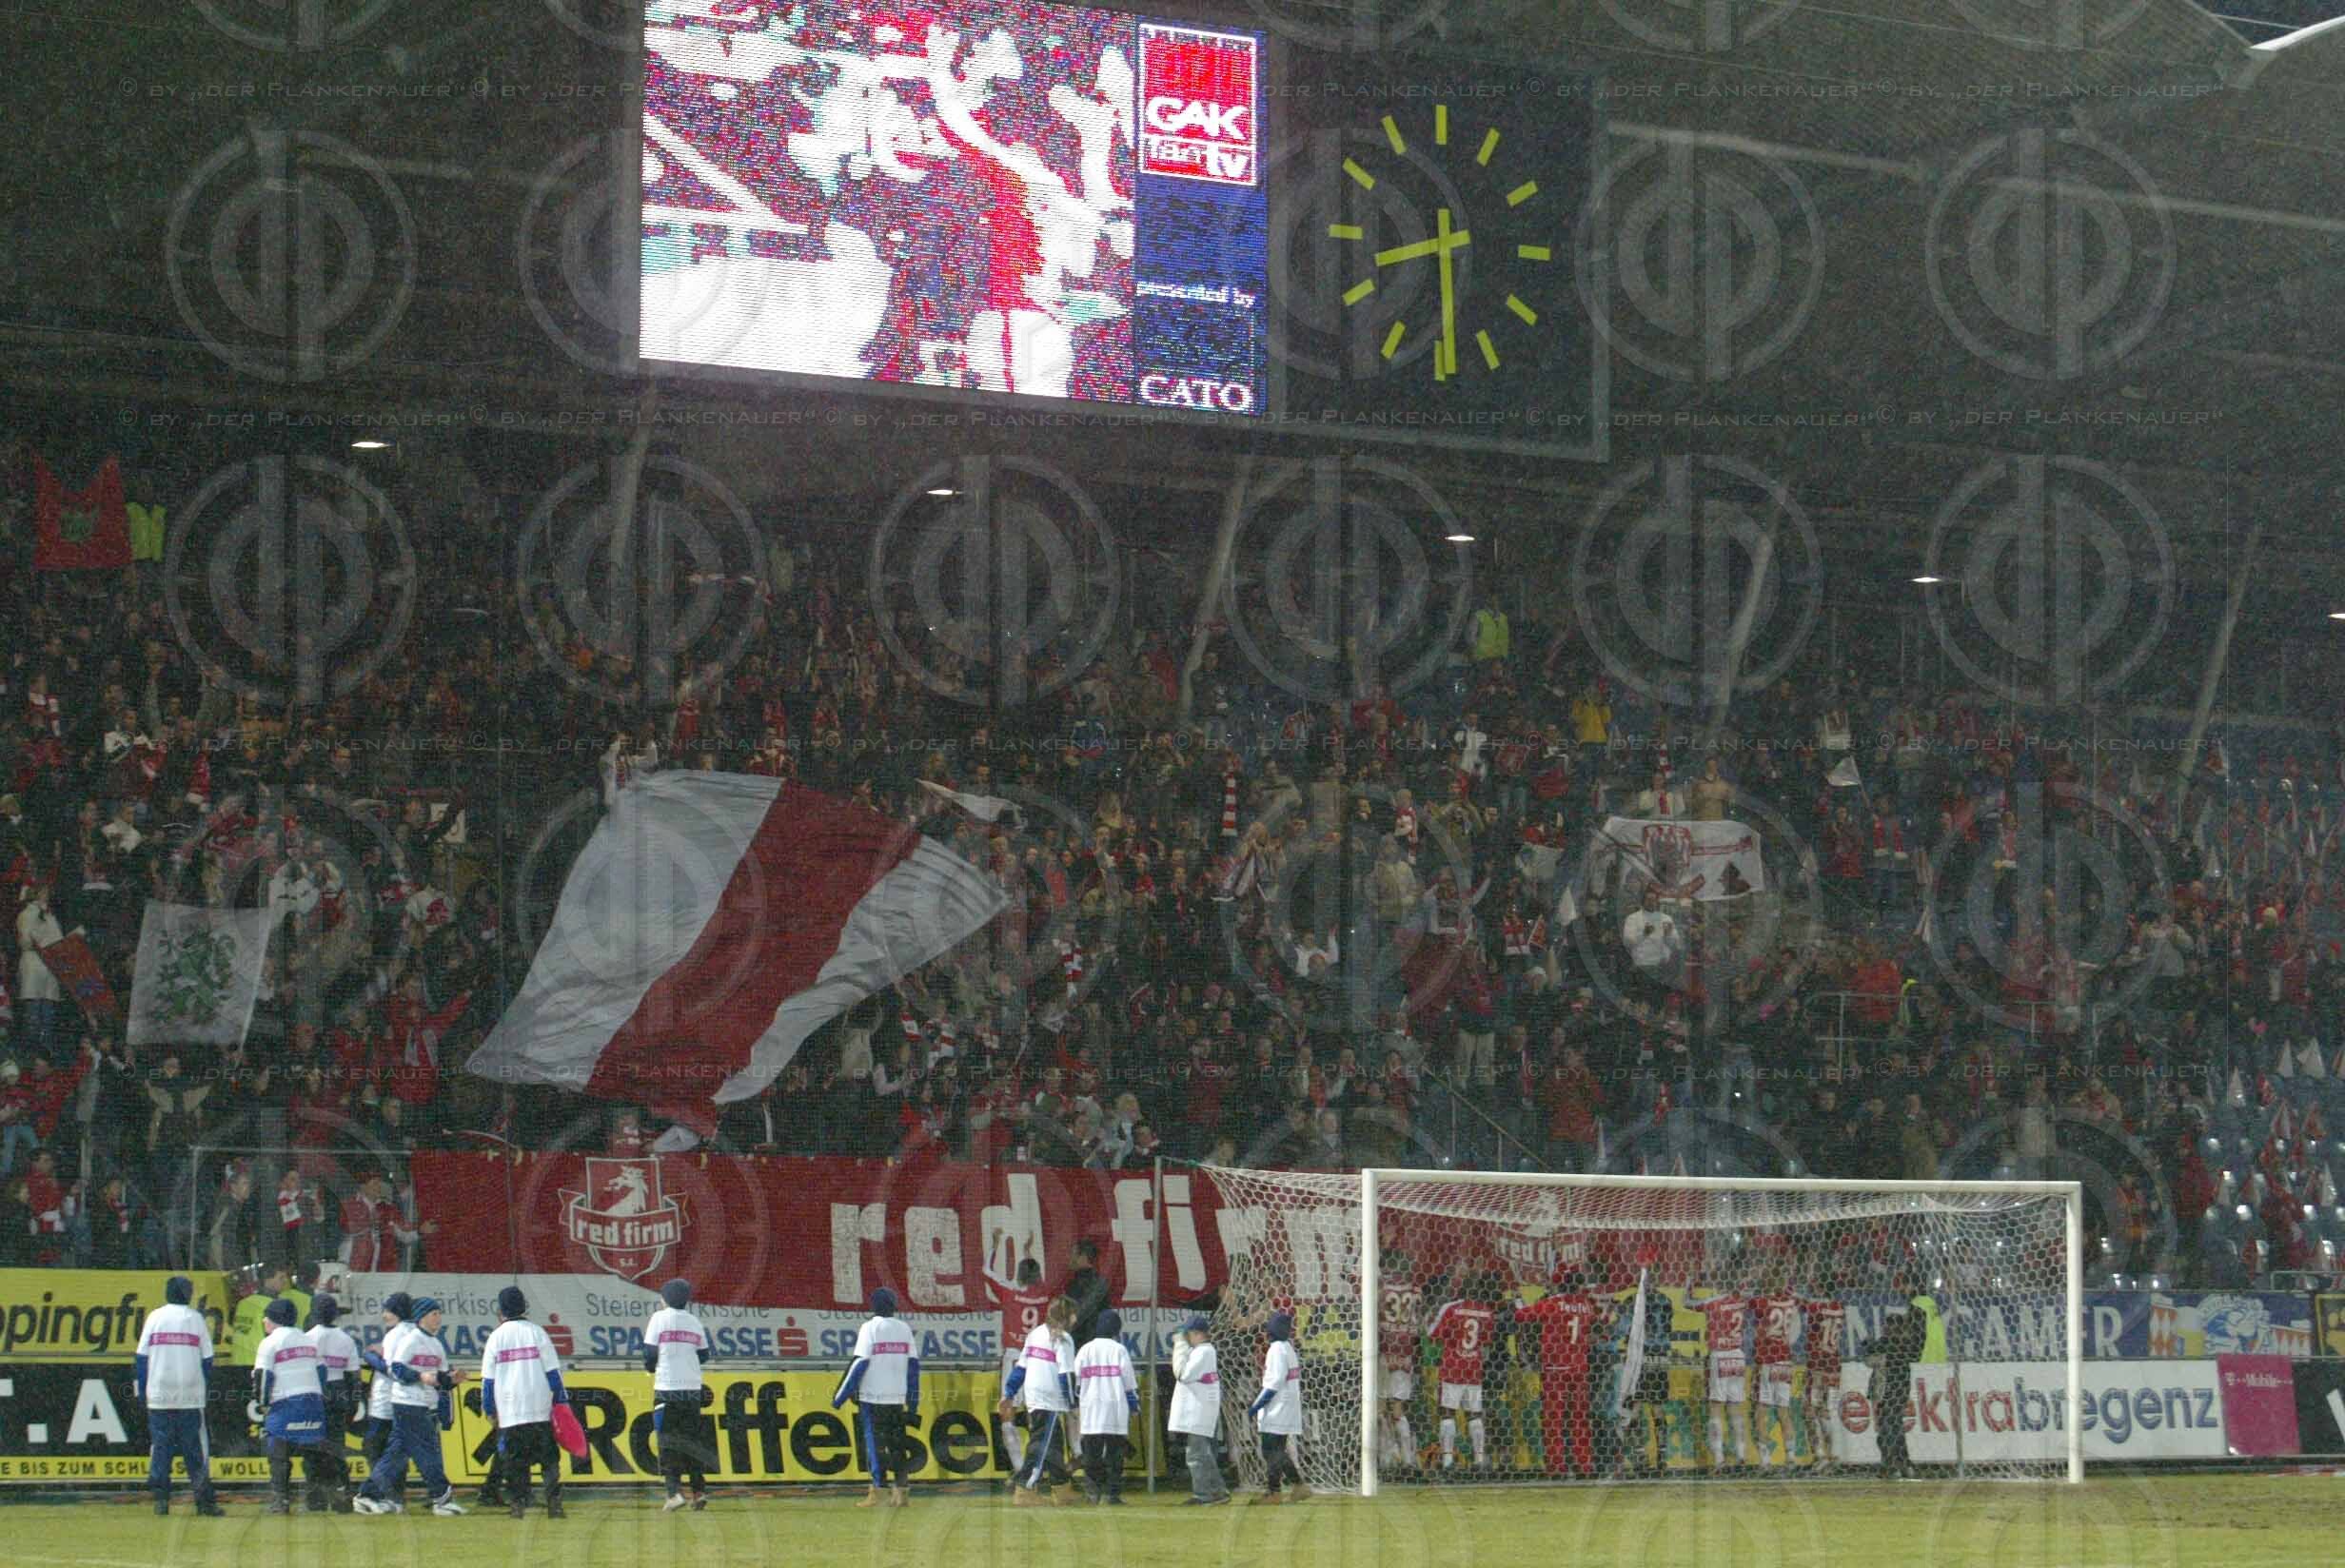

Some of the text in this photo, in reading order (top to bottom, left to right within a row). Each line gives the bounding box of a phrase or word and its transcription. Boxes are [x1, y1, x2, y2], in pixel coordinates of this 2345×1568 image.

[1147, 96, 1250, 140] GAK
[1232, 287, 1255, 308] by
[1140, 376, 1254, 412] CATO
[577, 1220, 674, 1246] red firm
[831, 1173, 1045, 1304] red
[1021, 1301, 1038, 1325] 9
[1461, 1318, 1479, 1349] 3
[20, 1461, 49, 1475] BIS
[57, 1461, 95, 1475] ZUM
